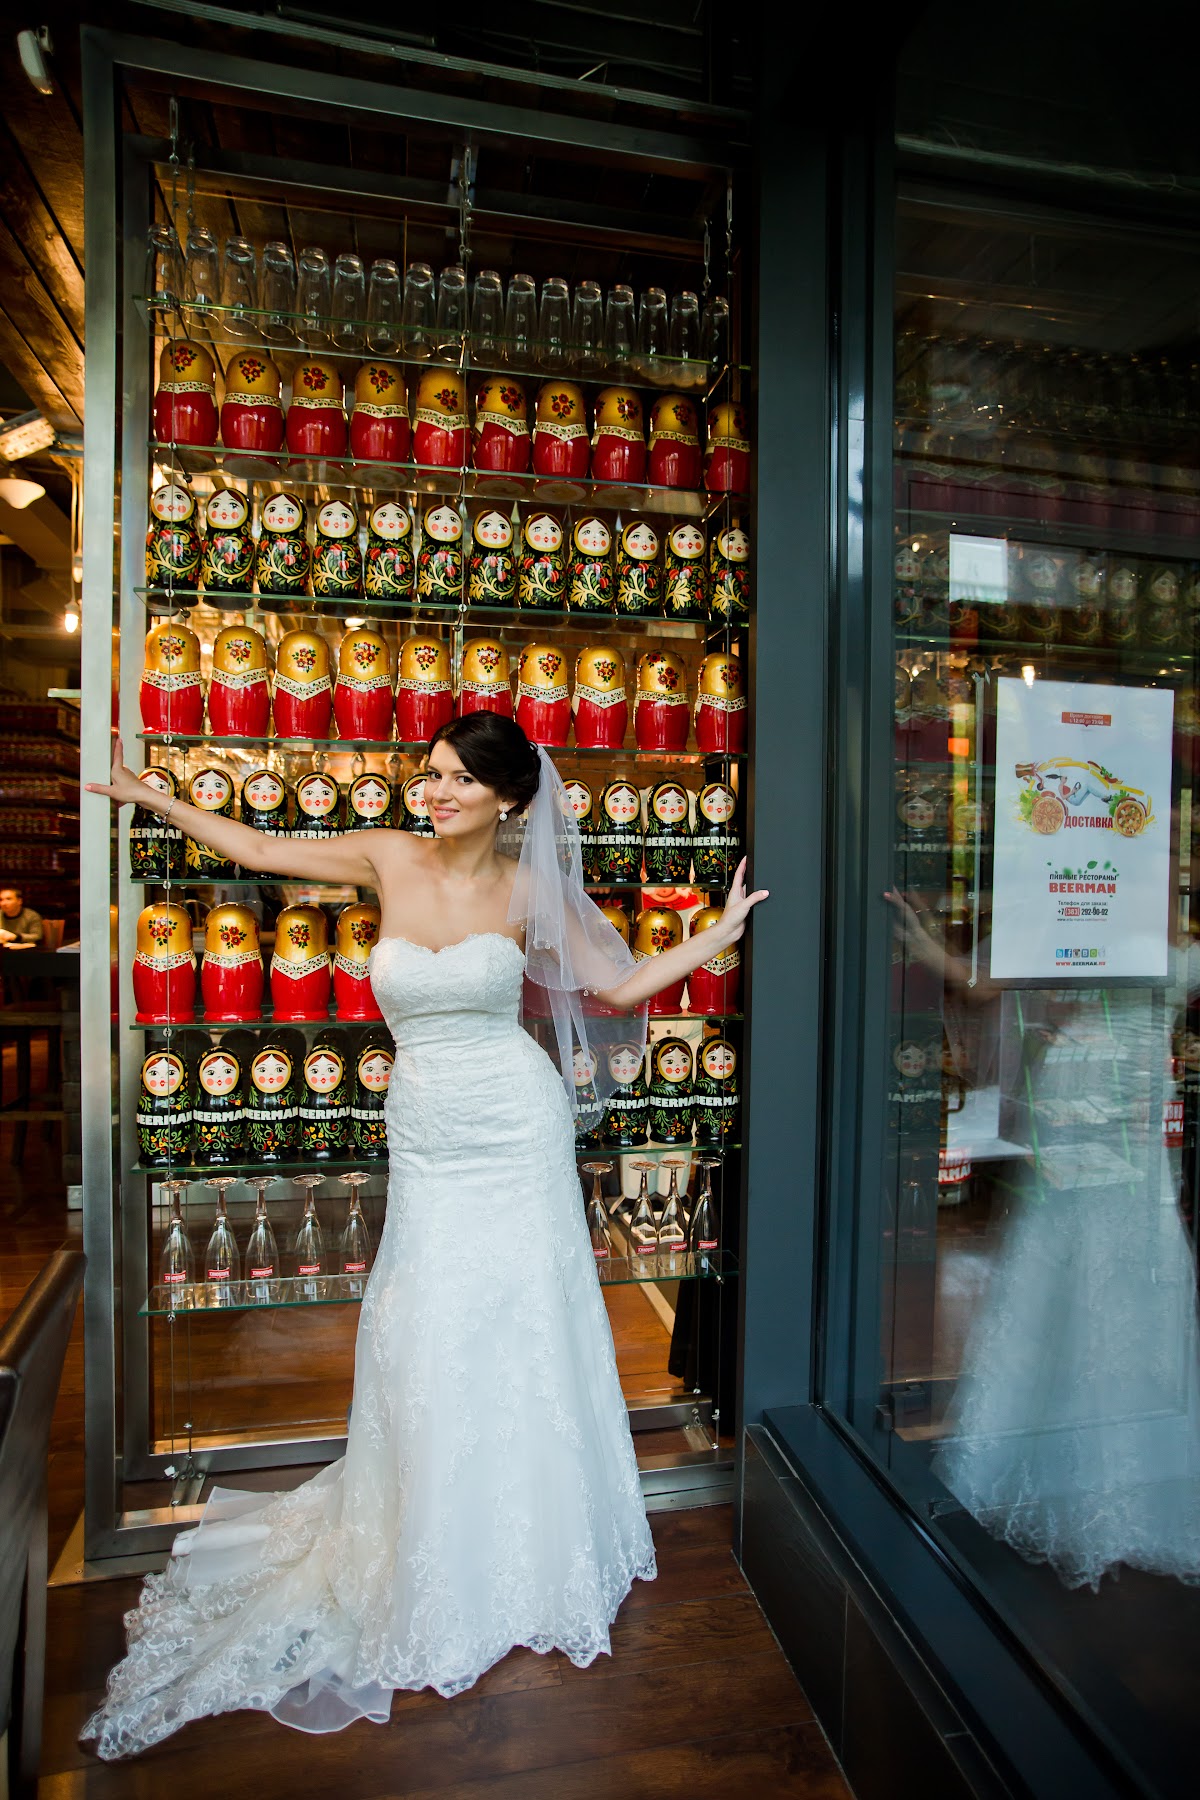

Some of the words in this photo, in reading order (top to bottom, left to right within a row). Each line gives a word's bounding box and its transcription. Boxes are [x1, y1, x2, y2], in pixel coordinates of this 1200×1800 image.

[1064, 815, 1113, 828] ДОСТАВКА
[130, 828, 182, 839] EERMAN
[291, 829, 345, 839] EERMA
[1049, 882, 1117, 894] BEERMAN
[1058, 908, 1065, 916] +7
[1065, 908, 1080, 916] (383)
[650, 1095, 695, 1108] BEERMA
[694, 1095, 740, 1108] BEERMA
